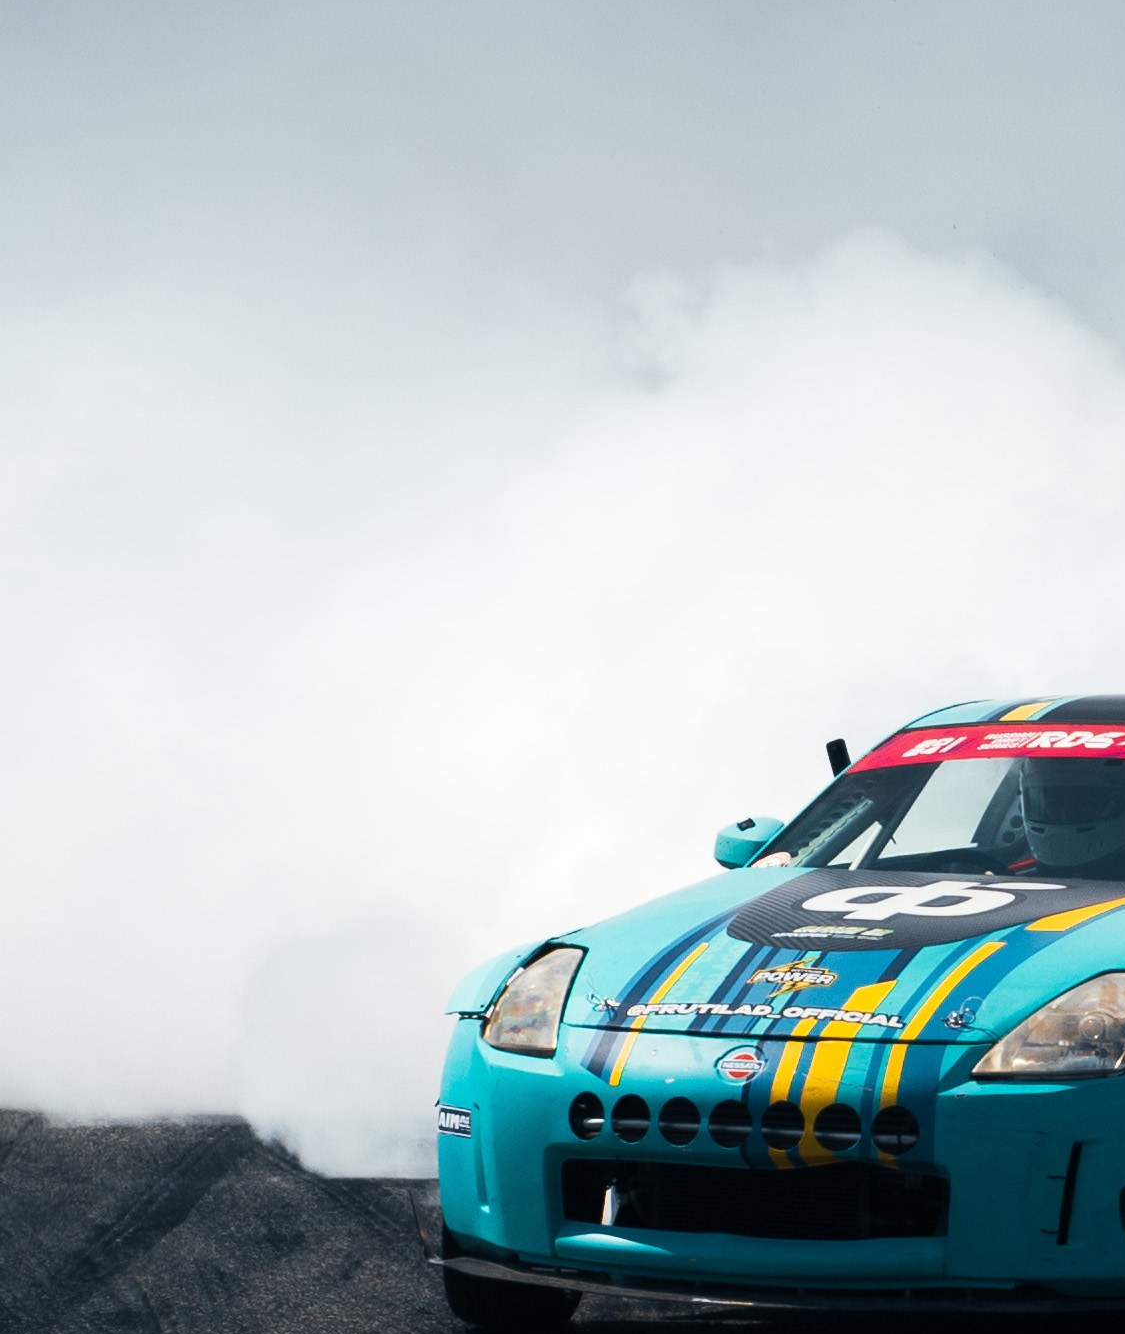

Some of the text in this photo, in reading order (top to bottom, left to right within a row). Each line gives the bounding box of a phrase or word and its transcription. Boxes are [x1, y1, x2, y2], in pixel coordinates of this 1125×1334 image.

[1027, 731, 1125, 749] RDS
[755, 971, 834, 985] POWER
[627, 1004, 904, 1028] @FRUTILAD_OFFICIAL
